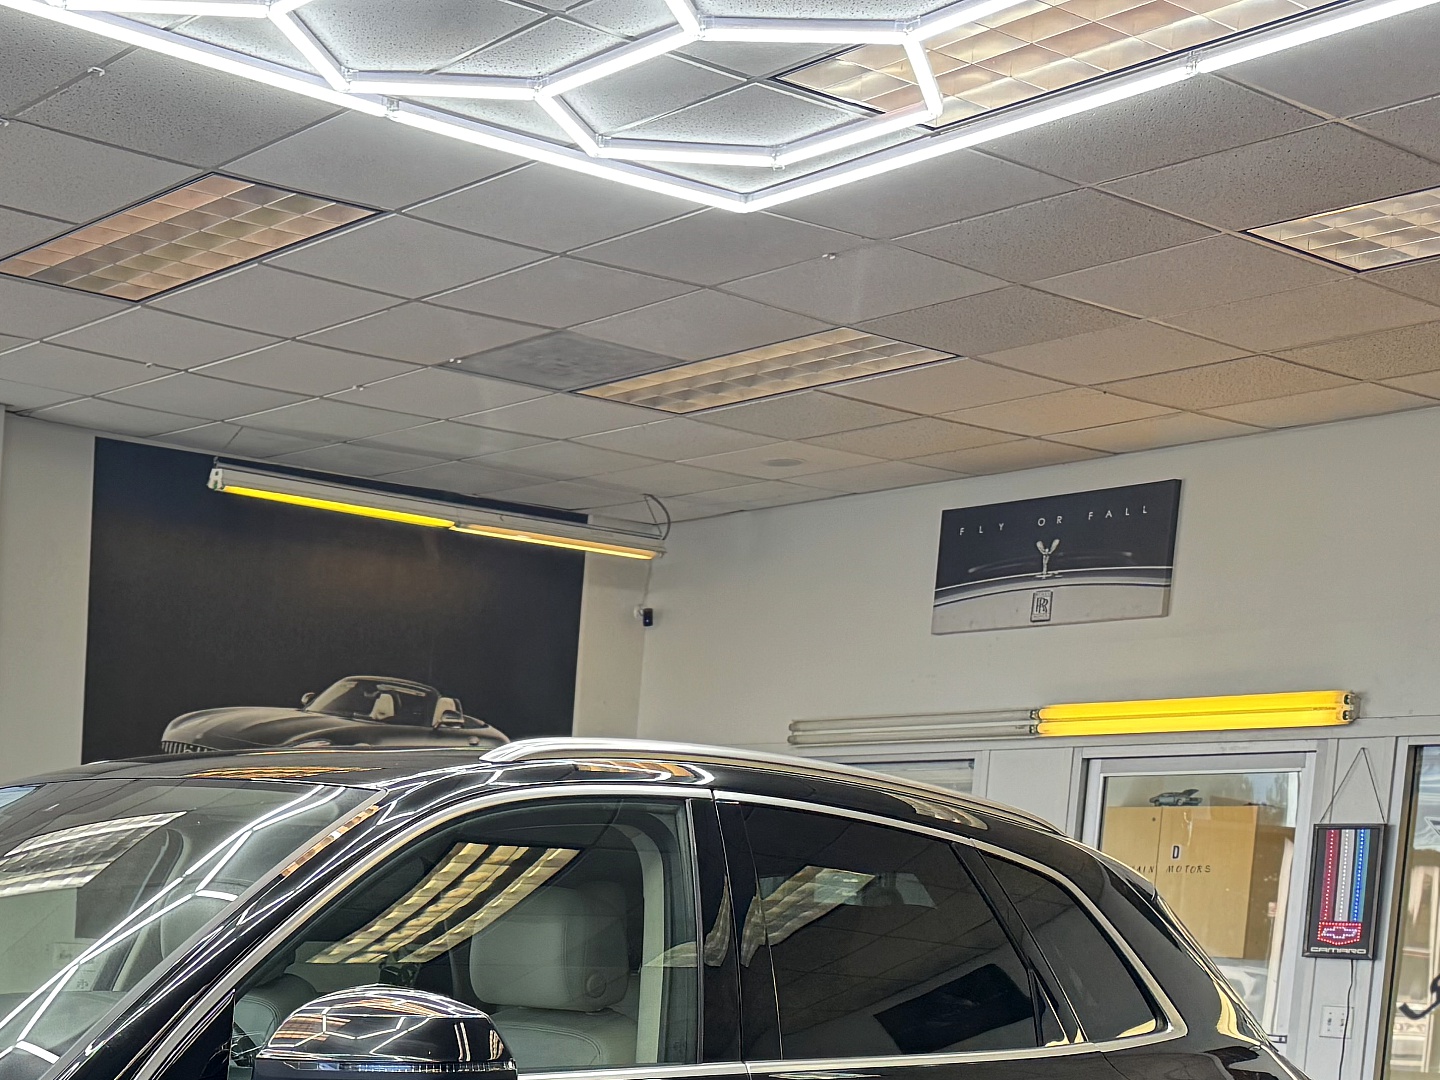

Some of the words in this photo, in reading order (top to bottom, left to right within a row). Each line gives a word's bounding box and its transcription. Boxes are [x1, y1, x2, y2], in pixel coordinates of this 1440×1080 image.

[959, 522, 1005, 536] FLY
[1037, 515, 1063, 527] OR
[1087, 505, 1148, 521] FALL
[1172, 845, 1180, 859] D
[1166, 864, 1211, 874] MOTORS
[1310, 946, 1367, 955] CAMARO
